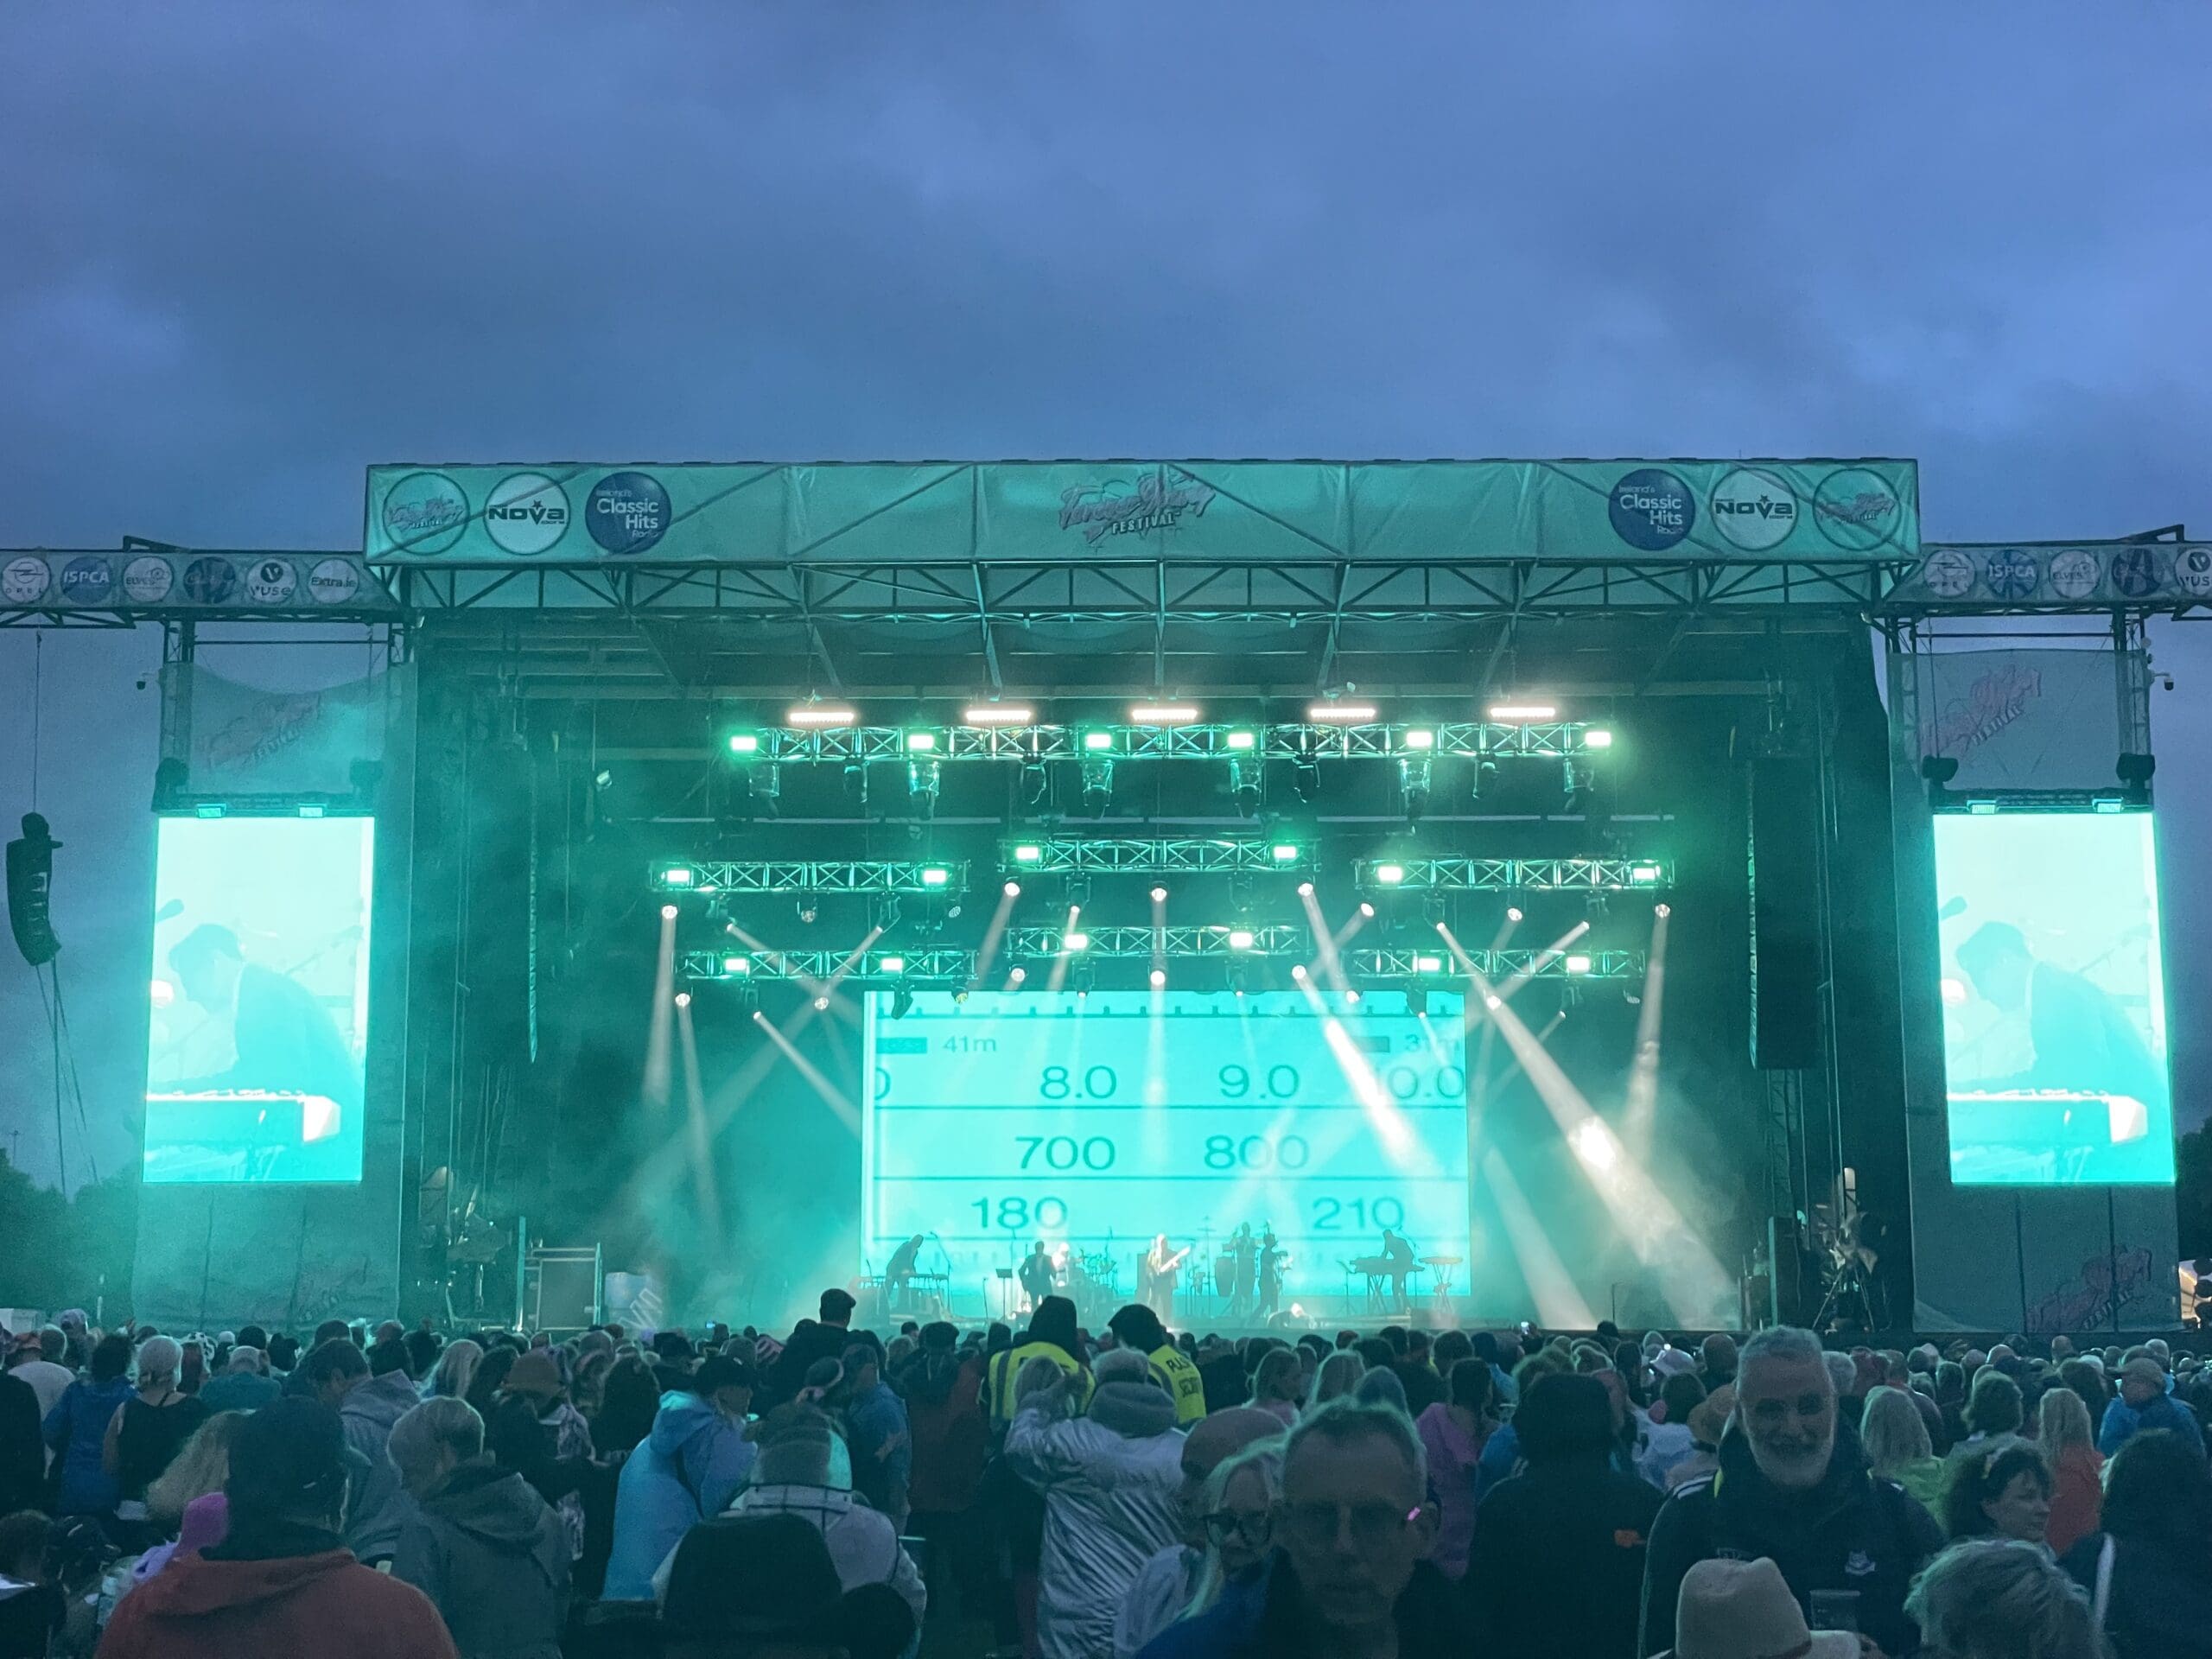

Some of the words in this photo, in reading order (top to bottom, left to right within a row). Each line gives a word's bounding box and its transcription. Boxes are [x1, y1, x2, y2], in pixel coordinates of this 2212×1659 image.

[597, 498, 658, 514] Classic
[1620, 493, 1681, 510] Classic
[626, 514, 658, 530] Hits
[1111, 512, 1175, 535] FESTIVAL
[1649, 510, 1682, 525] Hits
[63, 570, 110, 583] ISPCA
[1988, 563, 2036, 578] ISPCA
[943, 1035, 996, 1053] 41m
[1039, 1065, 1118, 1100] 8.0
[1218, 1064, 1300, 1099] 9.0
[1376, 1065, 1465, 1099] 0.0
[1014, 1135, 1116, 1171] 700
[1204, 1134, 1309, 1170] 800
[970, 1196, 1068, 1230] 180
[1313, 1196, 1404, 1230] 210
